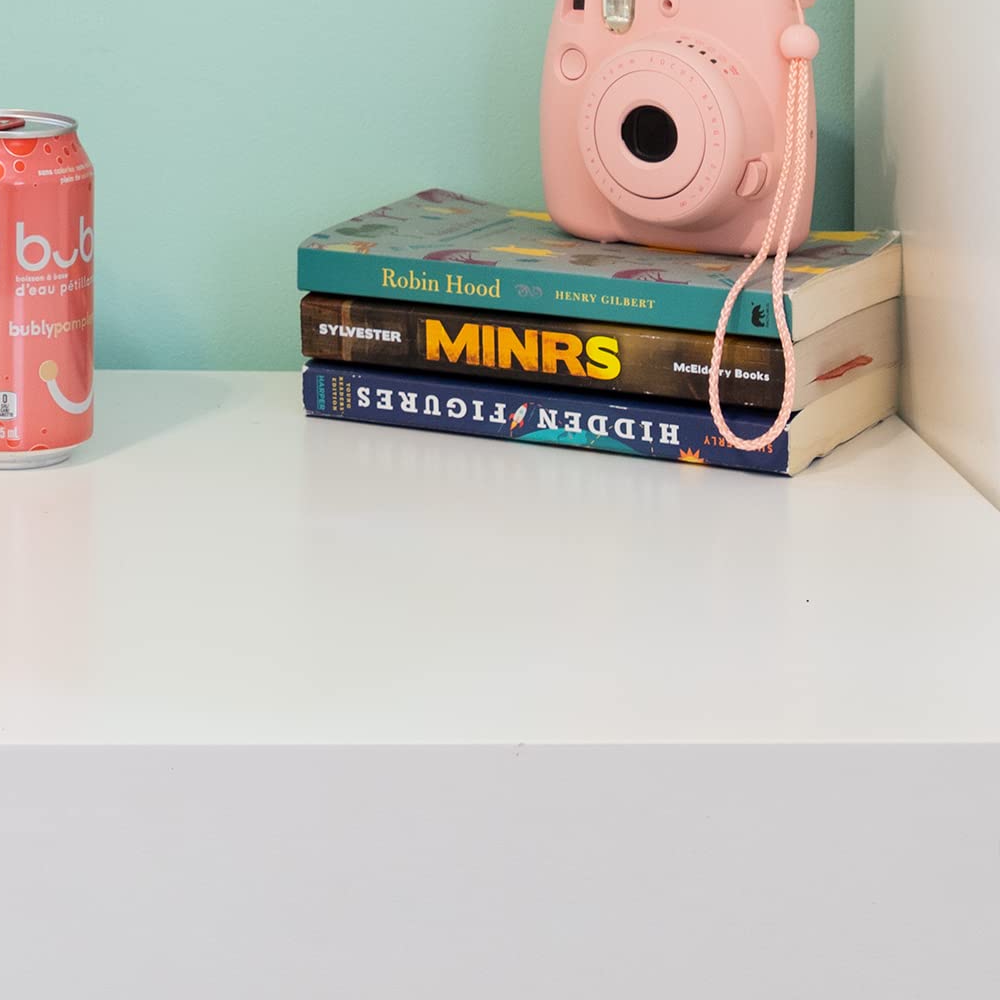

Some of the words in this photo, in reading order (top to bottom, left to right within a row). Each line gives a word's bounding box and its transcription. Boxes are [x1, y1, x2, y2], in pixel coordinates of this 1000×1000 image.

[15, 283, 55, 297] d'eau
[381, 267, 439, 293] Robin
[446, 273, 501, 299] Hood
[555, 290, 597, 304] HENRY
[601, 294, 656, 310] GILBERT
[319, 323, 402, 343] SYLVESTER
[425, 319, 622, 381] MINRS
[734, 368, 770, 382] Books
[356, 386, 507, 424] FIGURES
[536, 407, 681, 446] HIDDEN
